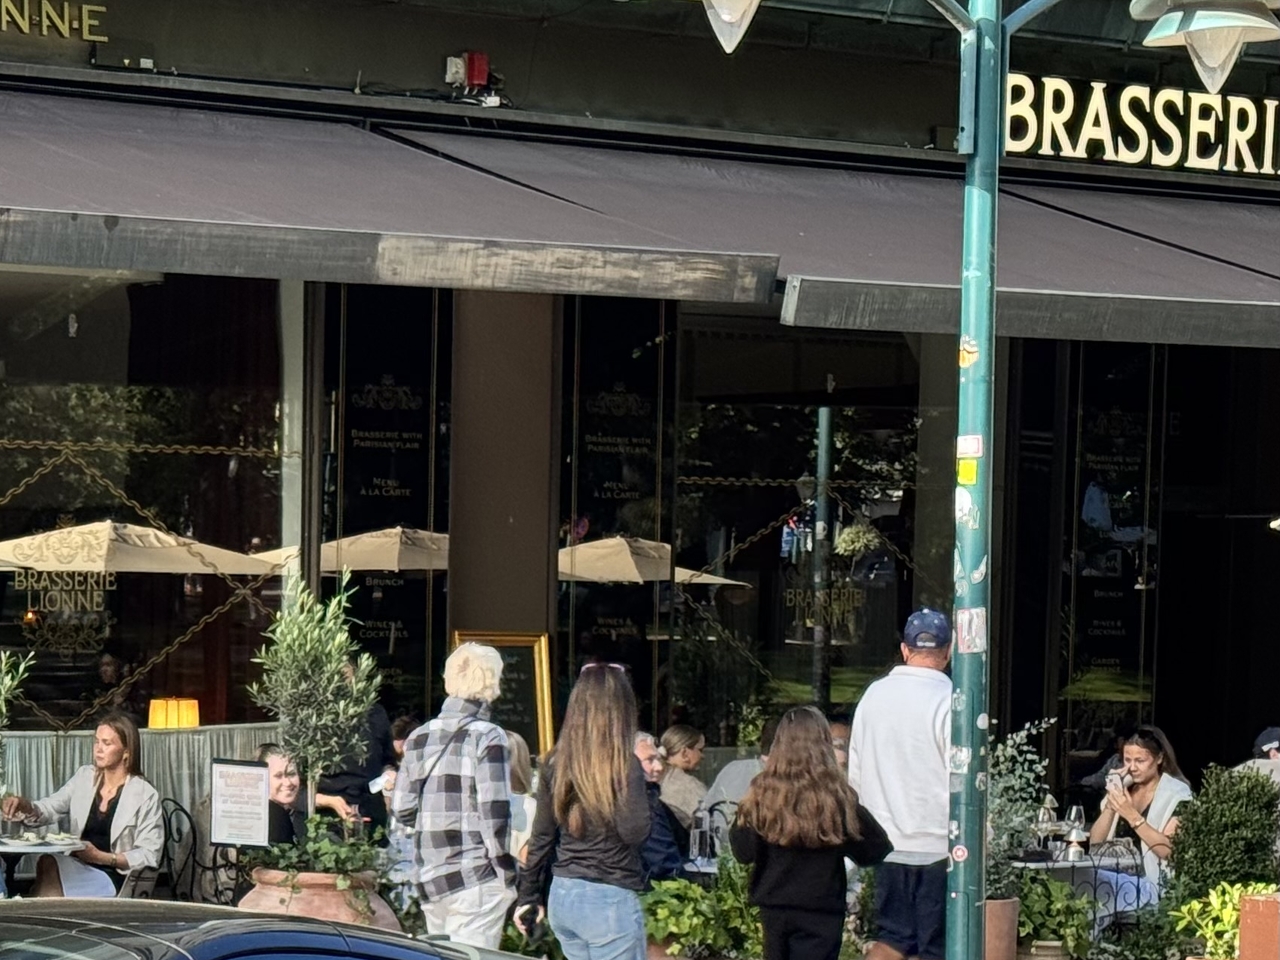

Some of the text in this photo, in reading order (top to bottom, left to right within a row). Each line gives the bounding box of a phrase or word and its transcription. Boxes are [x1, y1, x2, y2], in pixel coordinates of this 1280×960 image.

[1004, 73, 1280, 175] BRASSERI
[14, 569, 118, 591] BRASSERIE
[365, 576, 404, 587] BRUNCH
[27, 590, 105, 612] LIONNE
